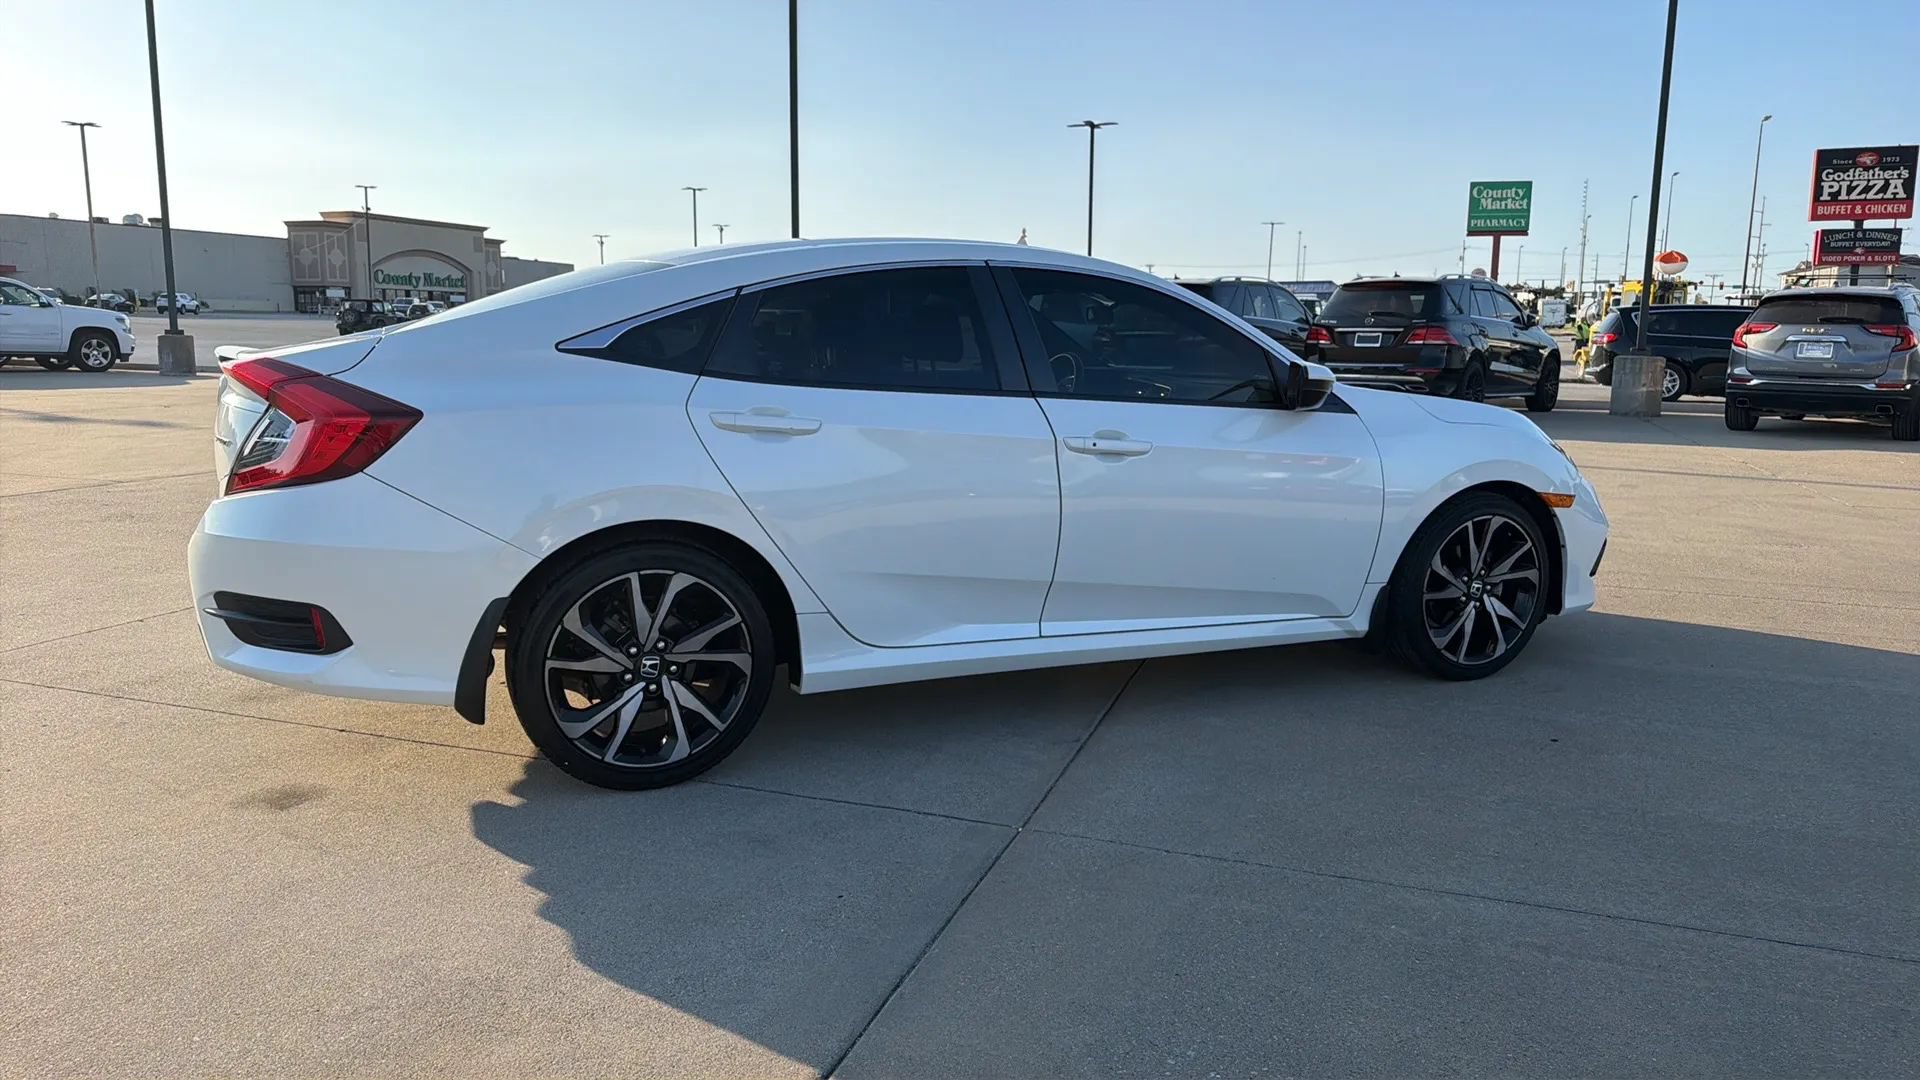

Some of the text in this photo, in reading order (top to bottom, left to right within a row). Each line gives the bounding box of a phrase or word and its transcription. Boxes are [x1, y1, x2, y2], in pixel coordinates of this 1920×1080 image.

[1821, 166, 1910, 181] Godfather's
[1472, 186, 1527, 199] County
[1819, 179, 1907, 201] PIZZA
[1479, 198, 1529, 210] Market
[1816, 203, 1907, 215] BUFFET & CHICKEN
[1470, 218, 1527, 227] PHARMACY
[1823, 231, 1855, 243] LUNCH
[1865, 231, 1899, 242] DINNER
[373, 268, 465, 289] County Market
